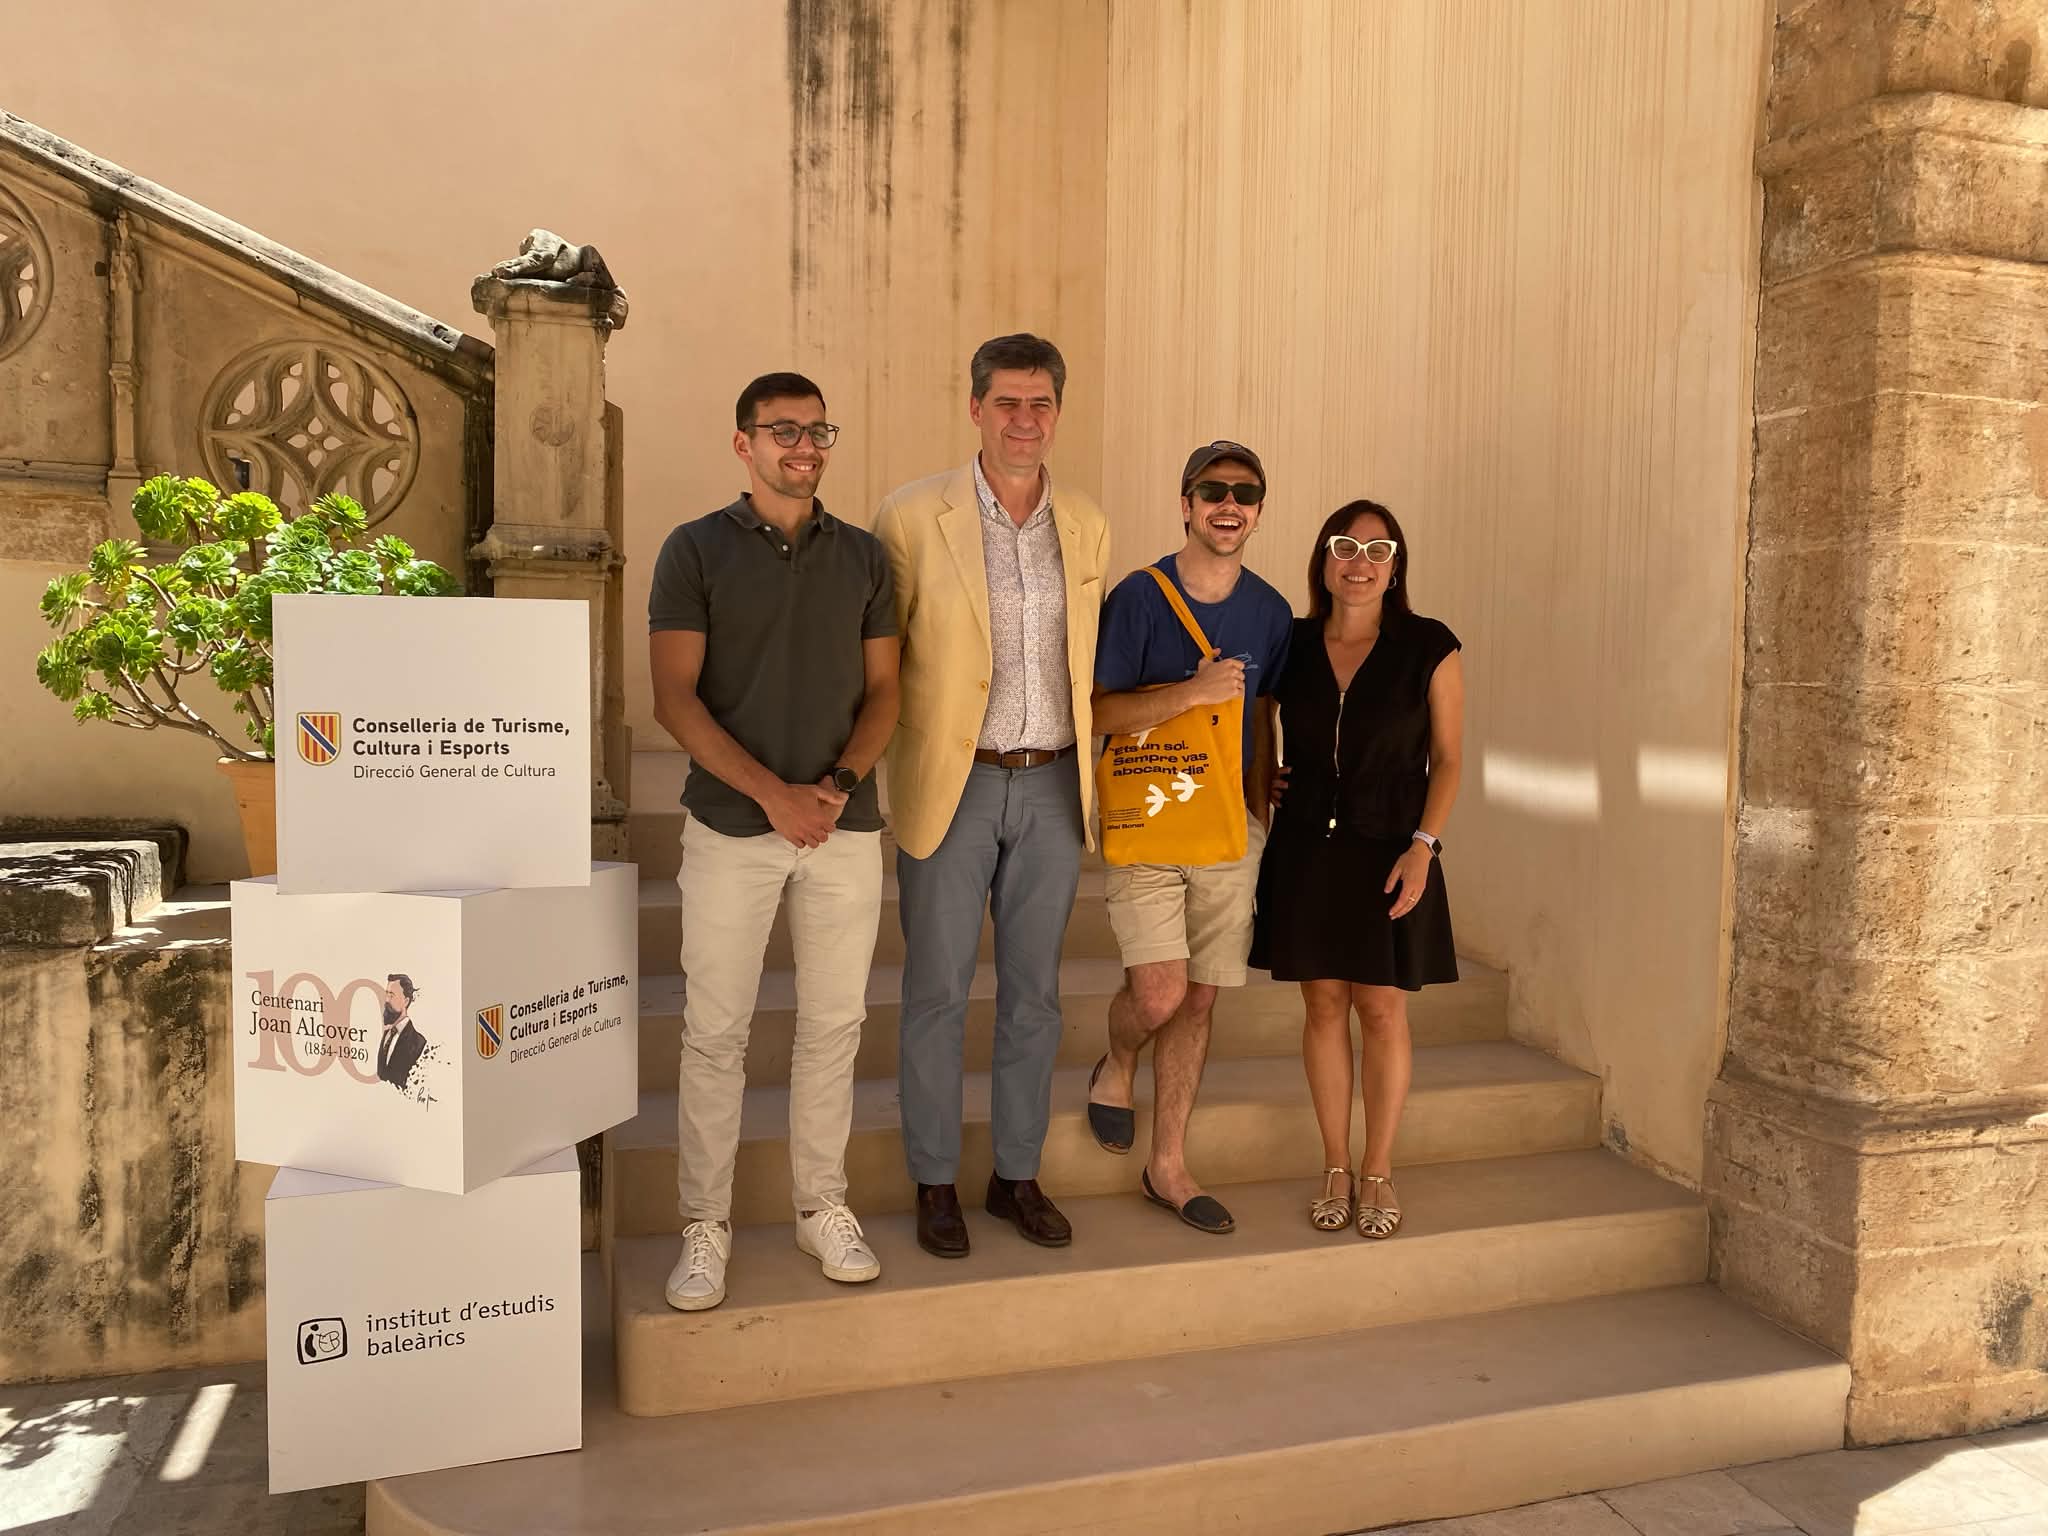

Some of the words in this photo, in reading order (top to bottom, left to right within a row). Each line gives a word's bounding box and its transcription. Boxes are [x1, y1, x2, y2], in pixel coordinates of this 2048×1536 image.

[352, 717, 457, 734] Conselleria
[463, 717, 485, 734] de
[492, 717, 570, 737] Turisme,
[352, 740, 421, 756] Cultura
[427, 740, 433, 756] i
[440, 740, 510, 760] Esports
[1141, 742, 1160, 752] un
[1163, 740, 1189, 751] sol.
[1113, 754, 1178, 766] Sempre
[1182, 752, 1208, 763] vas
[353, 763, 415, 779] Direcció
[419, 764, 476, 778] General
[481, 764, 499, 778] de
[503, 764, 556, 778] Cultura
[1113, 765, 1179, 777] abocant
[251, 990, 325, 1013] Centenari
[510, 990, 570, 1020] Conselleria
[572, 985, 585, 1001] de
[588, 974, 629, 995] Turisme,
[246, 969, 388, 1085] 100
[249, 1011, 291, 1036] Joan
[296, 1017, 368, 1043] Alcover
[510, 1017, 550, 1041] Cultura
[552, 1012, 556, 1028] i
[559, 1002, 598, 1025] Esports
[510, 1041, 546, 1064] Direcció
[548, 1029, 580, 1050] General
[582, 1024, 592, 1038] de
[593, 1015, 622, 1033] Cultura
[304, 1041, 369, 1063] (1854-1926)
[366, 1307, 451, 1333] institut
[460, 1294, 555, 1321] d'estudis
[367, 1329, 466, 1357] baleàrics
